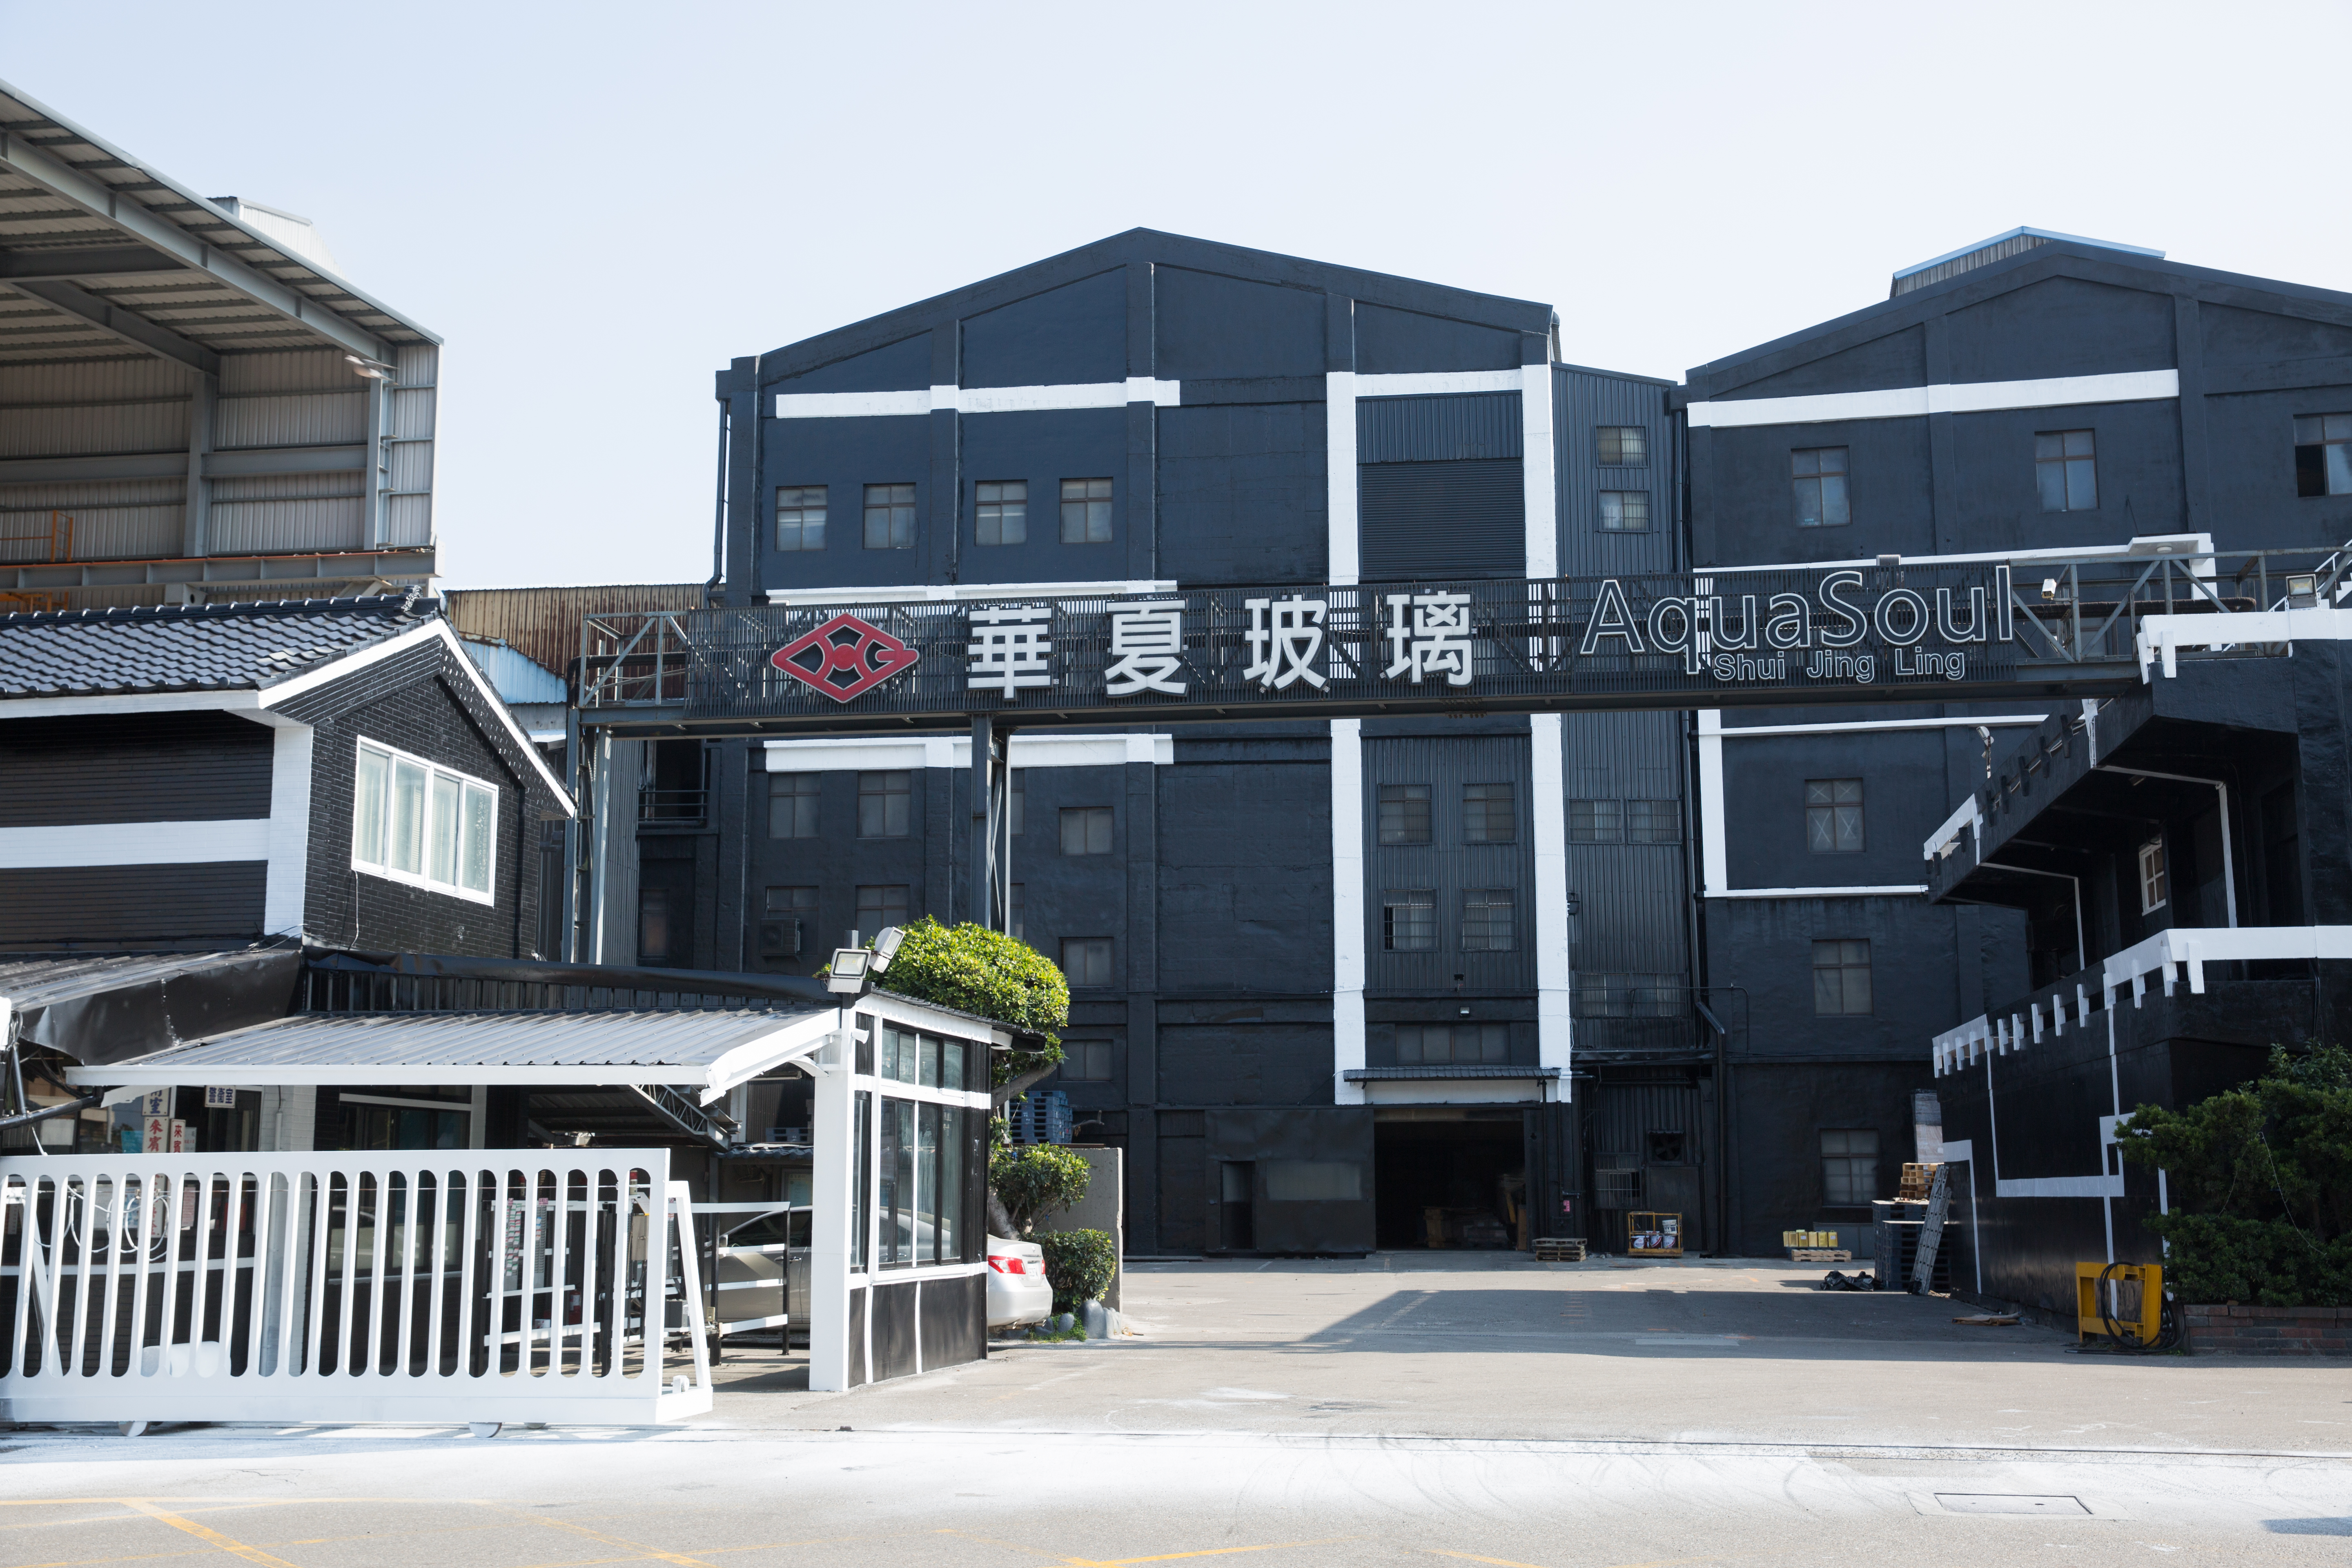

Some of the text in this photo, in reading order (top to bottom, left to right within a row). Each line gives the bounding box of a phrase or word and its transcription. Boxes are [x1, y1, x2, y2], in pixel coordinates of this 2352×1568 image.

[968, 590, 1472, 699] 華夏玻璃
[1580, 565, 2013, 675] AquaSoul
[1714, 646, 1965, 684] Shui Jing Ling
